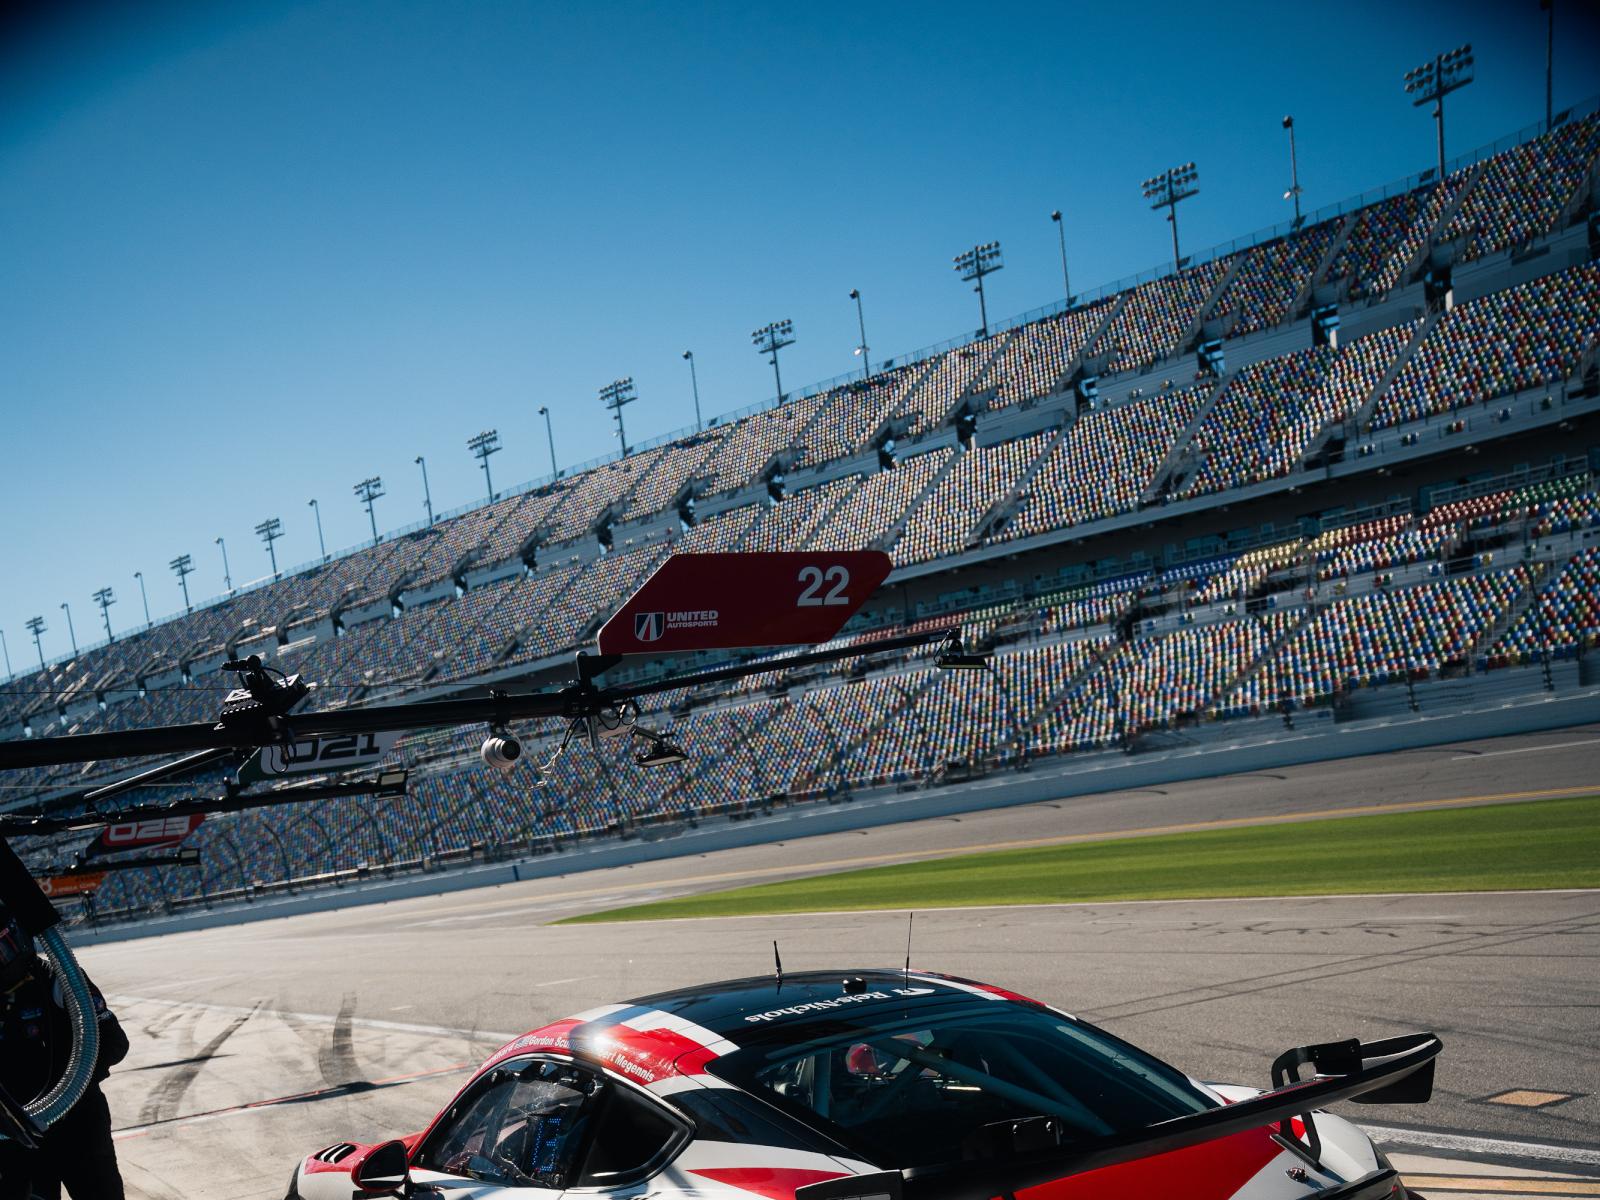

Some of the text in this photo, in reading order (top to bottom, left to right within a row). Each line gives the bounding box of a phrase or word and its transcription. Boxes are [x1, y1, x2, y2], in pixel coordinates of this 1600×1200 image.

[797, 565, 850, 607] 22
[666, 610, 719, 623] UNITED
[666, 620, 719, 629] AUTOSPORTS
[109, 815, 191, 843] 023
[614, 1053, 656, 1083] Megennis
